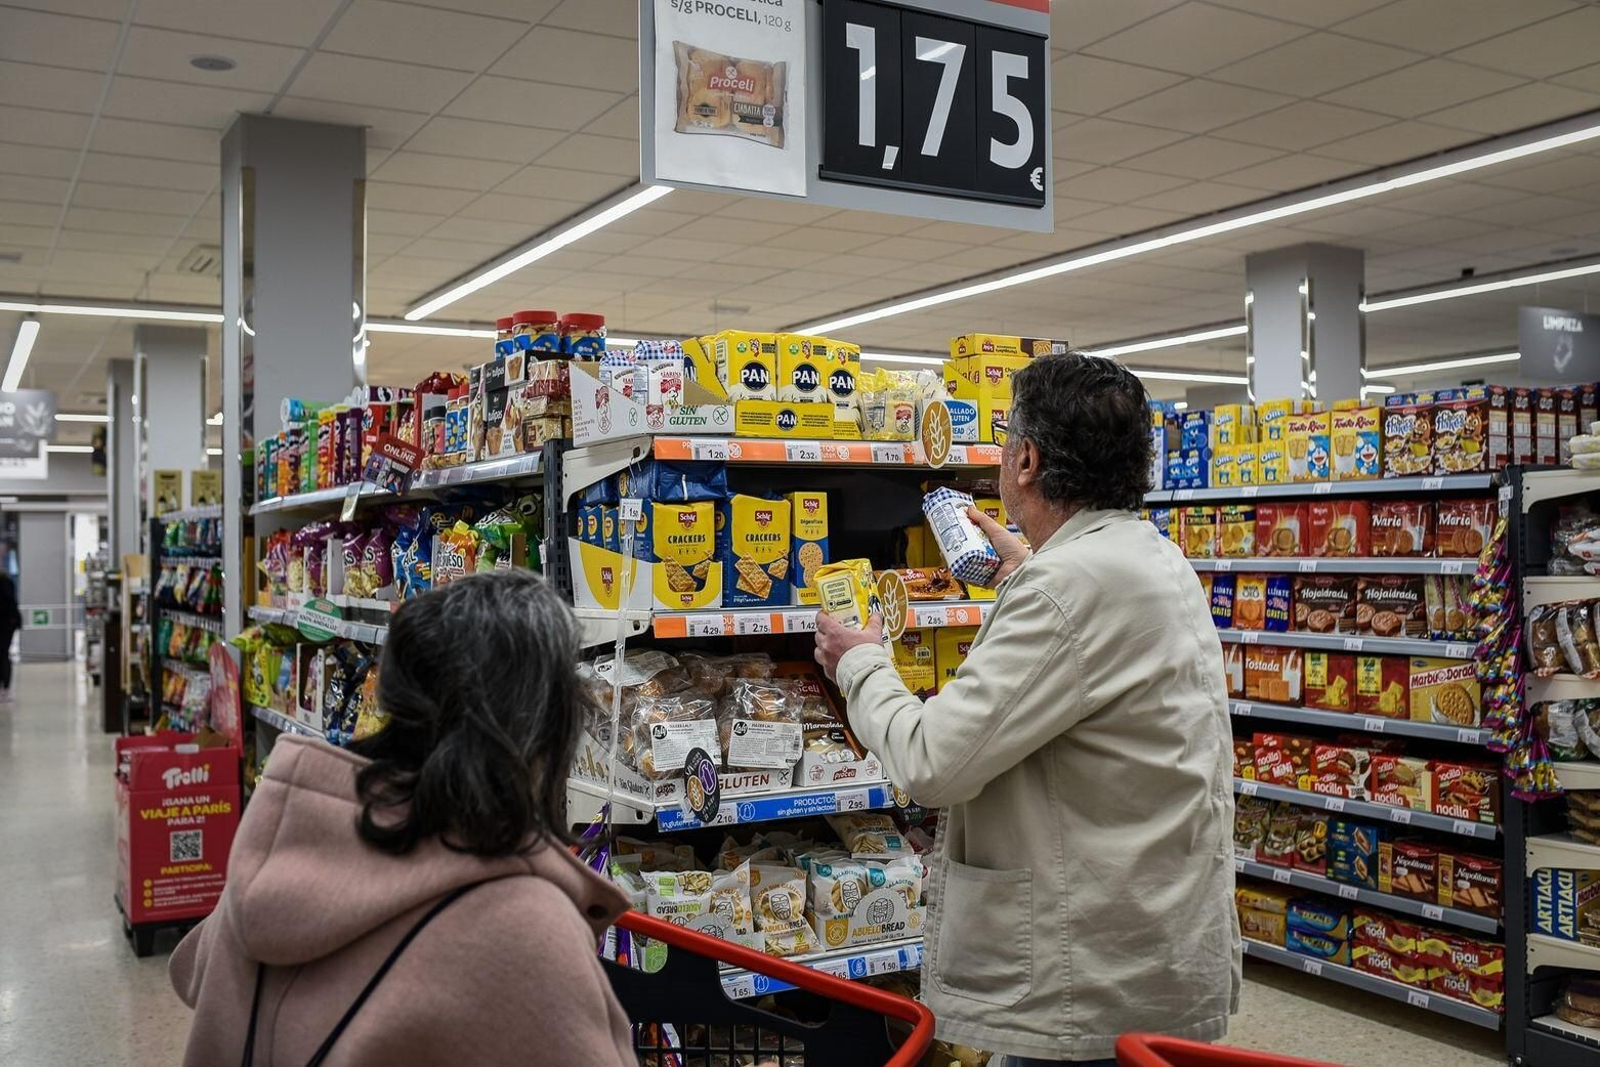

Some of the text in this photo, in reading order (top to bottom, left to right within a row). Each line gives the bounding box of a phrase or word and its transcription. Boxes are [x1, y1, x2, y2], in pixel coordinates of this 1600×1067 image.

[671, 0, 693, 14] s/g
[696, 1, 761, 25] PROCELI,
[764, 15, 783, 28] 120
[785, 20, 792, 32] g
[710, 76, 754, 92] Proceli
[845, 22, 1044, 191] 1,75 €
[679, 405, 698, 415] SIN
[669, 416, 708, 426] GLUTEN
[1288, 420, 1327, 433] Tosta Rica
[1334, 416, 1376, 429] Tosta Rica
[952, 427, 965, 435] READ
[383, 443, 416, 464] ONLINE
[668, 534, 706, 544] CRACKERS
[745, 533, 781, 542] CRACKERS
[1302, 589, 1348, 600] Hojaldrada
[1365, 589, 1418, 601] Hojaldrada
[1212, 606, 1231, 617] GRATIS
[1266, 609, 1288, 620] GRATIS
[752, 624, 768, 632] 2.75
[1245, 658, 1280, 672] Tostada
[946, 668, 957, 677] PA
[1411, 672, 1438, 689] Marbú
[162, 763, 210, 789] Trolli
[719, 774, 770, 790] GLUTEN
[1315, 782, 1342, 796] nocilla
[794, 795, 835, 806] PRODUCTOS
[1374, 793, 1404, 806] nocilla
[141, 803, 231, 819] VIAJE A PARÍS
[787, 808, 803, 816] gluten
[1436, 804, 1469, 819] nocilla
[167, 817, 193, 826] PARA
[161, 863, 212, 875] PARTICIPA:
[1394, 856, 1434, 871] Napolitanas
[1455, 868, 1498, 885] Napolitanas
[1302, 911, 1333, 924] DUCALES
[852, 921, 905, 938] ABUELOBREAD
